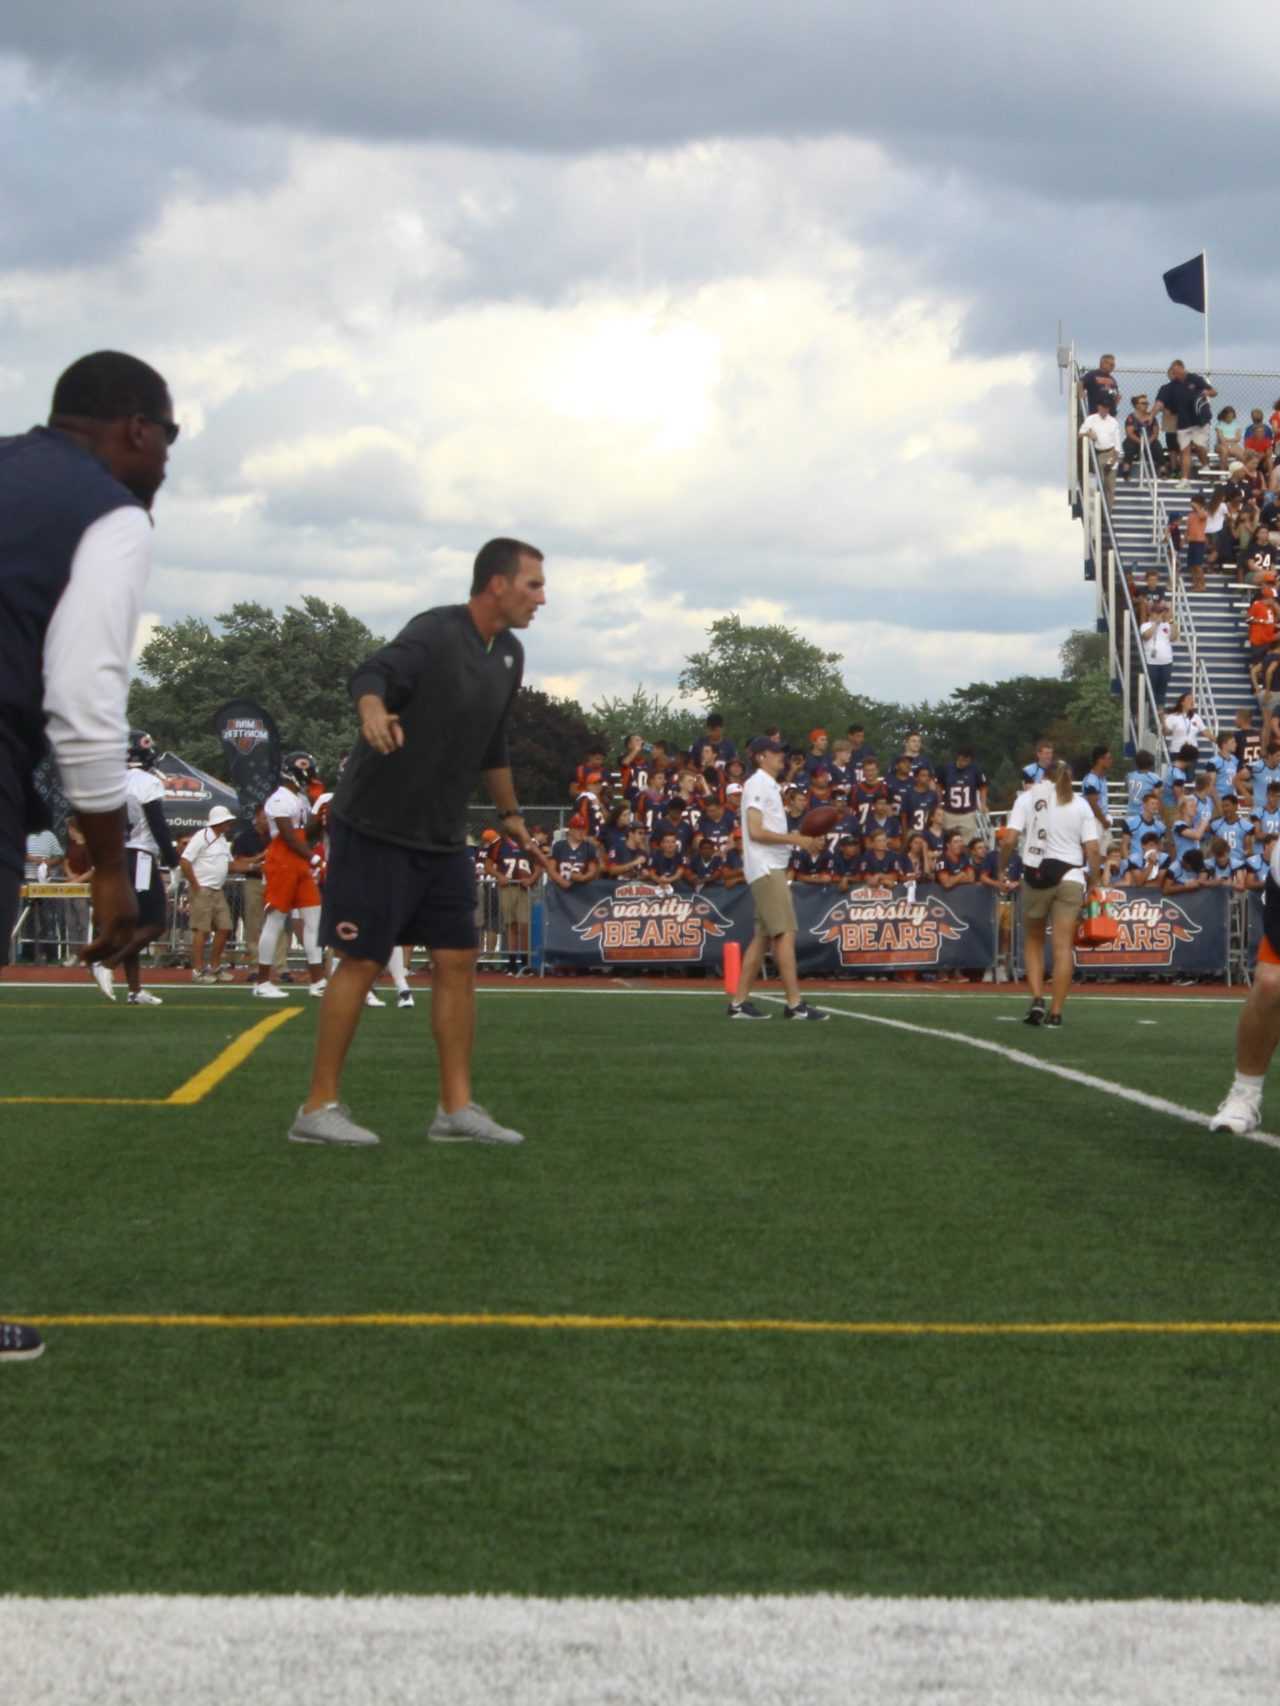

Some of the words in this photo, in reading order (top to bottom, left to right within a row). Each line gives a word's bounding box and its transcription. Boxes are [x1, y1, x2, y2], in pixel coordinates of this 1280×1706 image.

[949, 786, 972, 808] 51
[612, 899, 692, 922] varsity
[849, 902, 928, 925] varsity
[603, 918, 701, 947] BEARS
[841, 921, 938, 950] BEARS
